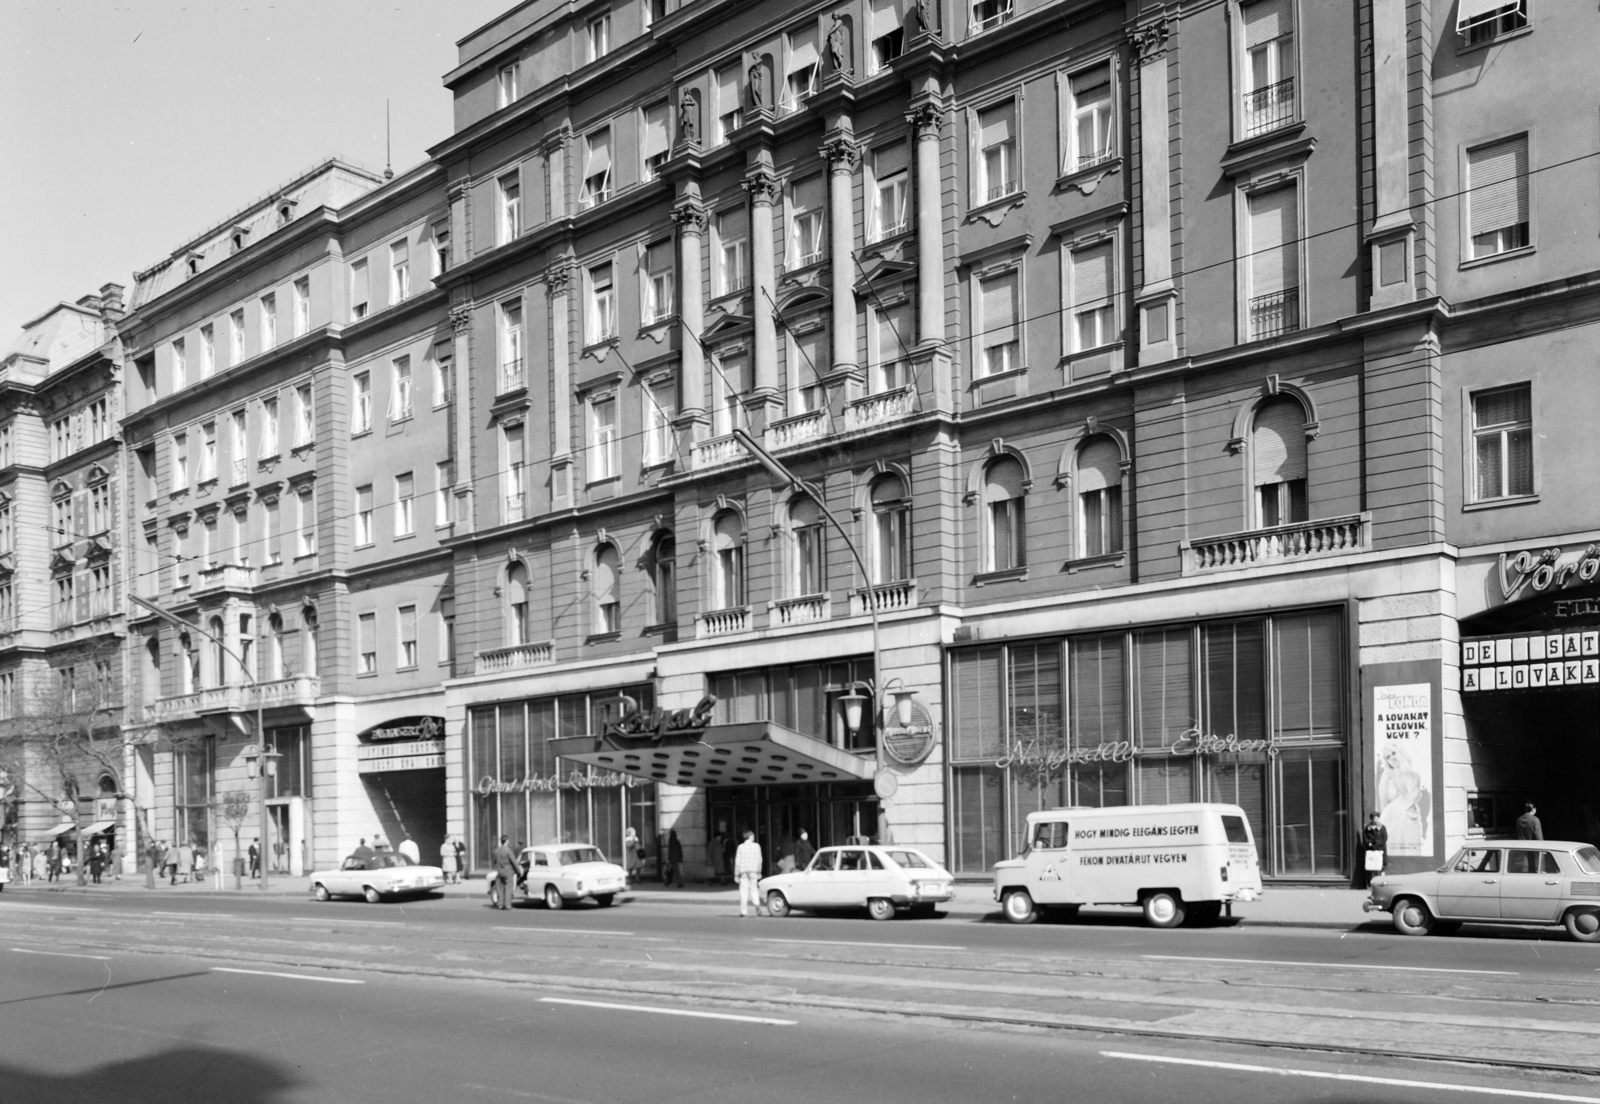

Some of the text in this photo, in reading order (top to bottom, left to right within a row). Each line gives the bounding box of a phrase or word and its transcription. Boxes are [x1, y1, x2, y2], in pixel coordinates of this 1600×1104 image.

[1554, 598, 1600, 617] FIL
[1466, 645, 1490, 660] DE
[1465, 665, 1596, 687] A LOVAKA
[1389, 695, 1428, 709] FONDA
[594, 694, 717, 740] Royal
[1378, 712, 1428, 722] A LOVAKAT
[1386, 731, 1409, 739] UGYE
[1075, 825, 1199, 839] HOGY MINDIG ELEGÁNS LEGYEN
[1080, 853, 1187, 866] FÉKON DIVATÁRUT VEGYEN
